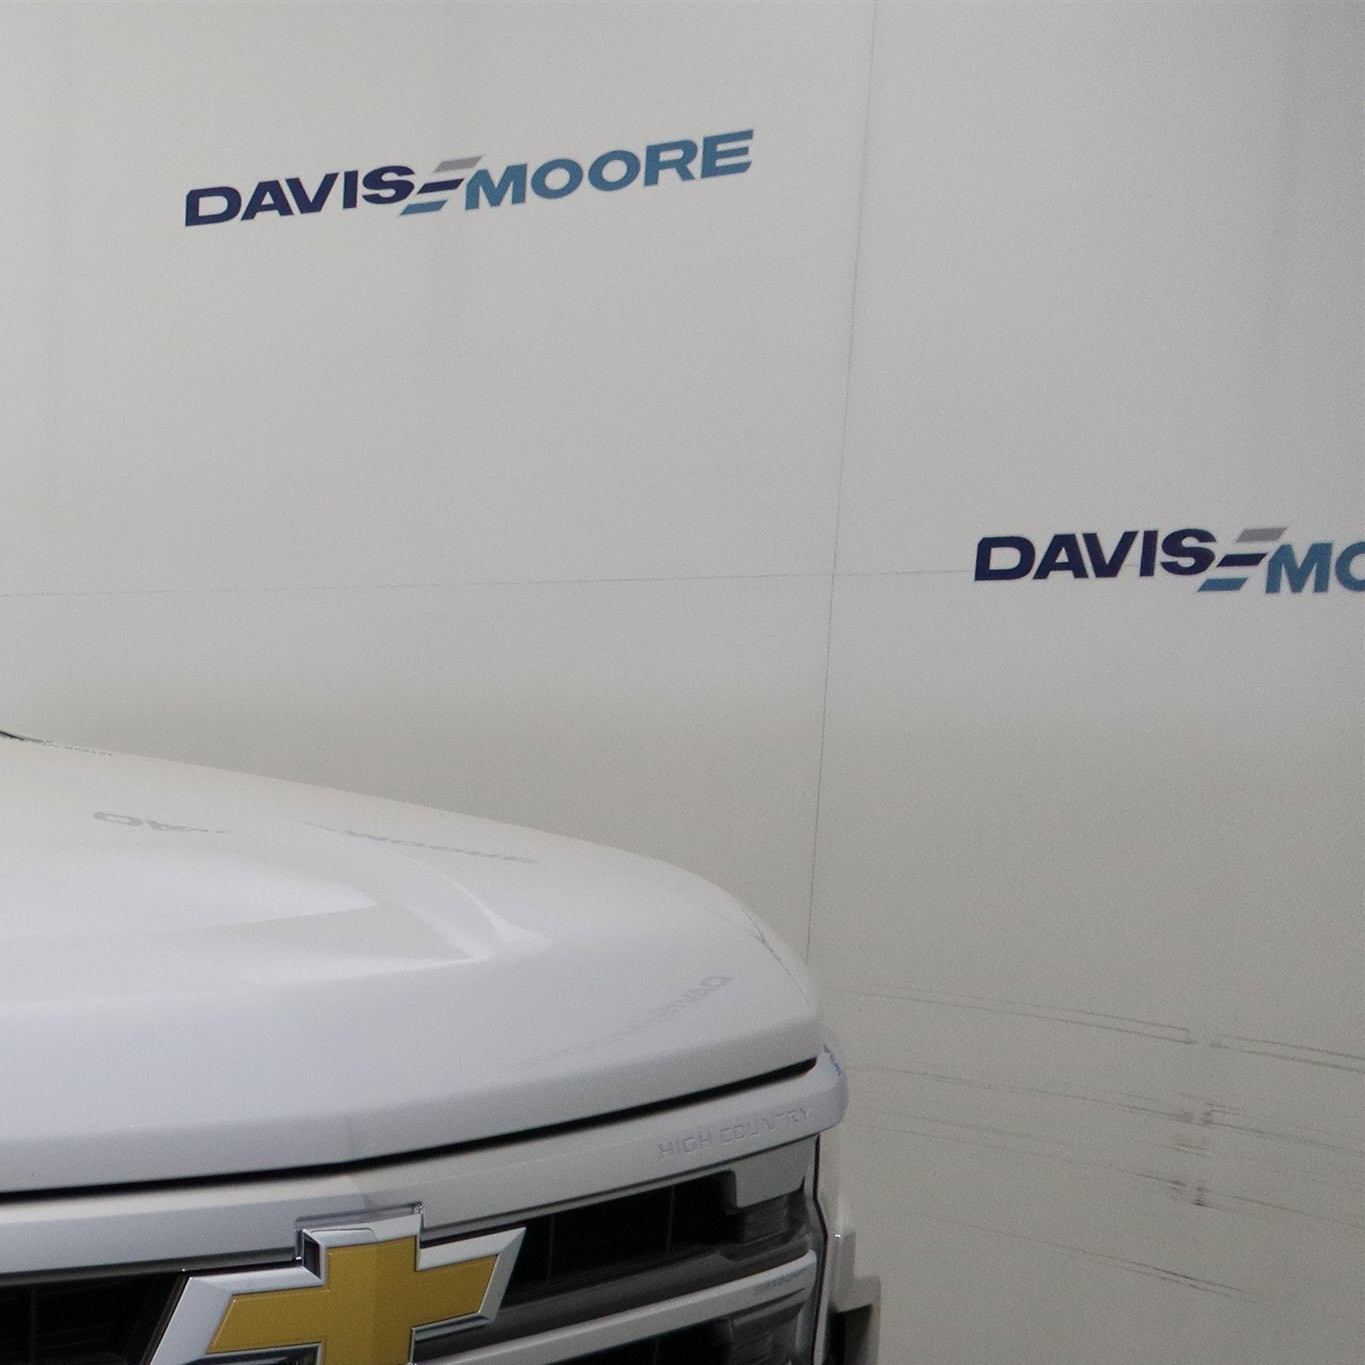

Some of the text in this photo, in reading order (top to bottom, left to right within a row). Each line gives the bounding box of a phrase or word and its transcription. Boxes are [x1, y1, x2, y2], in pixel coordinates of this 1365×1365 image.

[185, 129, 754, 226] DAVIS MOORE
[974, 528, 1216, 581] DAVIS
